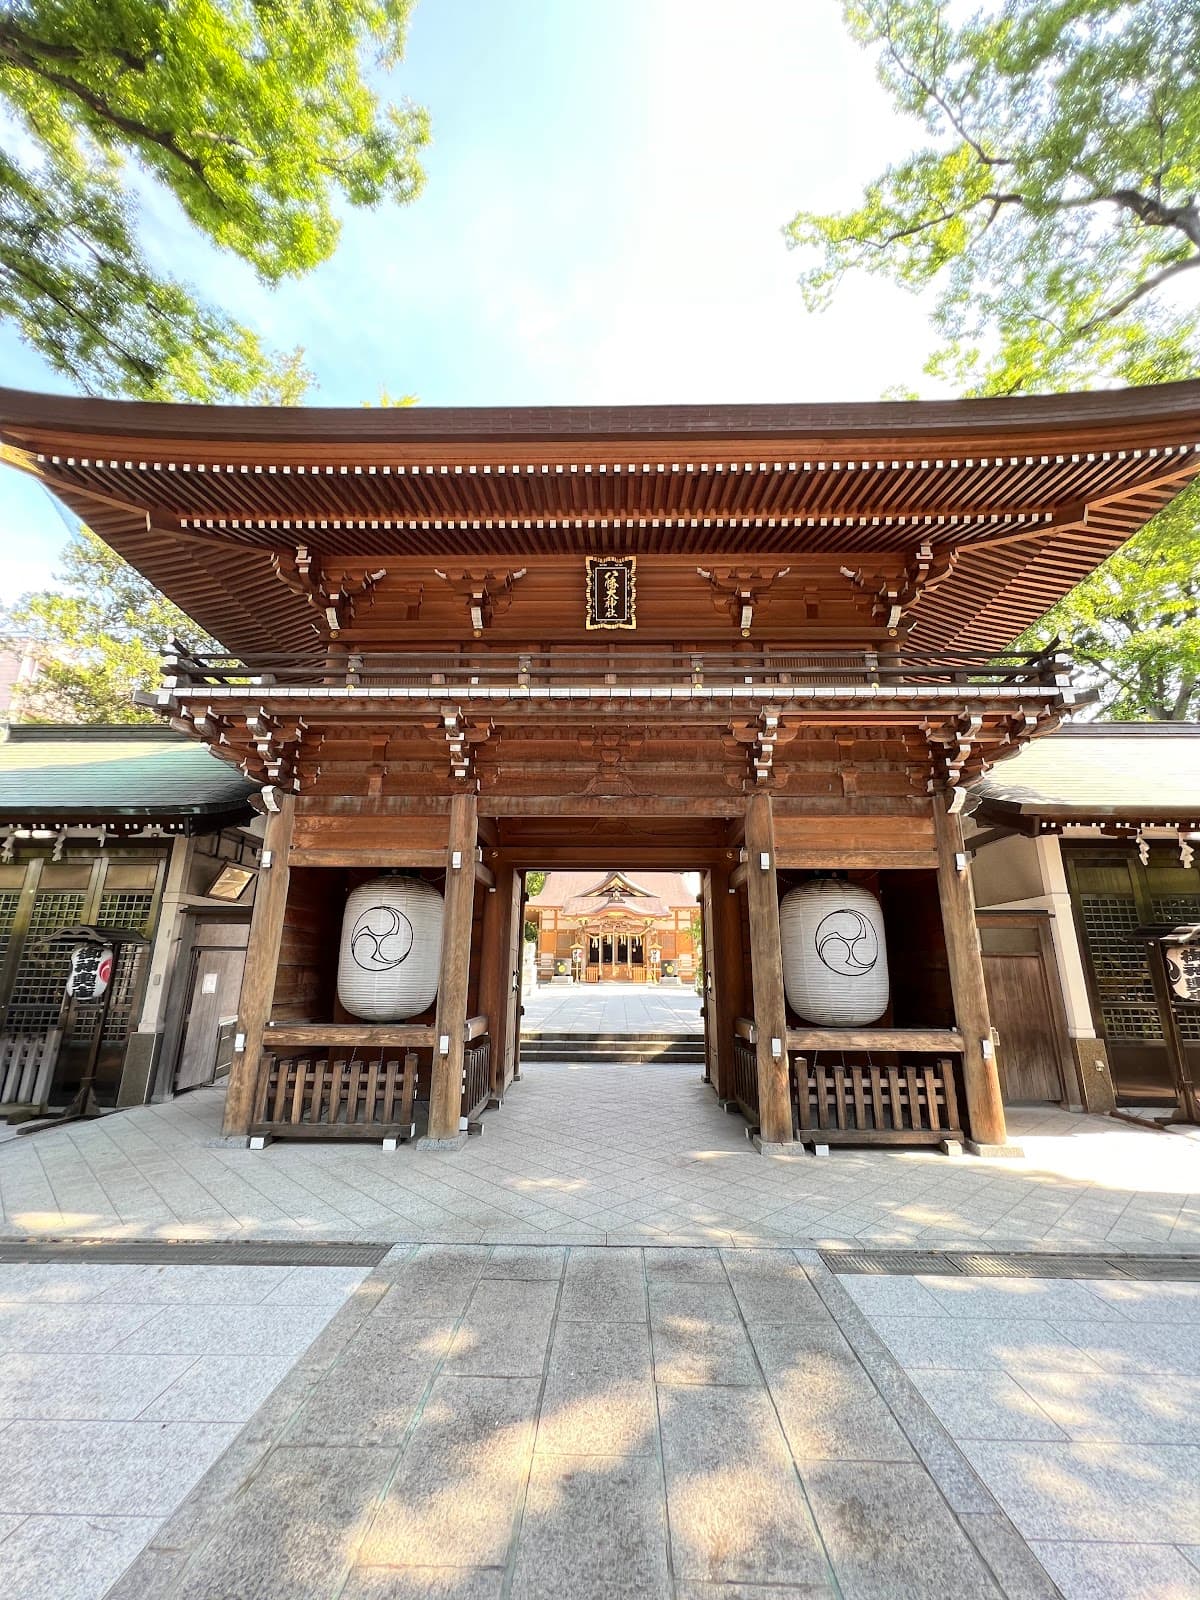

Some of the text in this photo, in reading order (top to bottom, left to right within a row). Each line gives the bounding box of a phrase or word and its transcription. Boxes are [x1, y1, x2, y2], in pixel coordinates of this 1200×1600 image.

[604, 570, 619, 617] 八幡大神社
